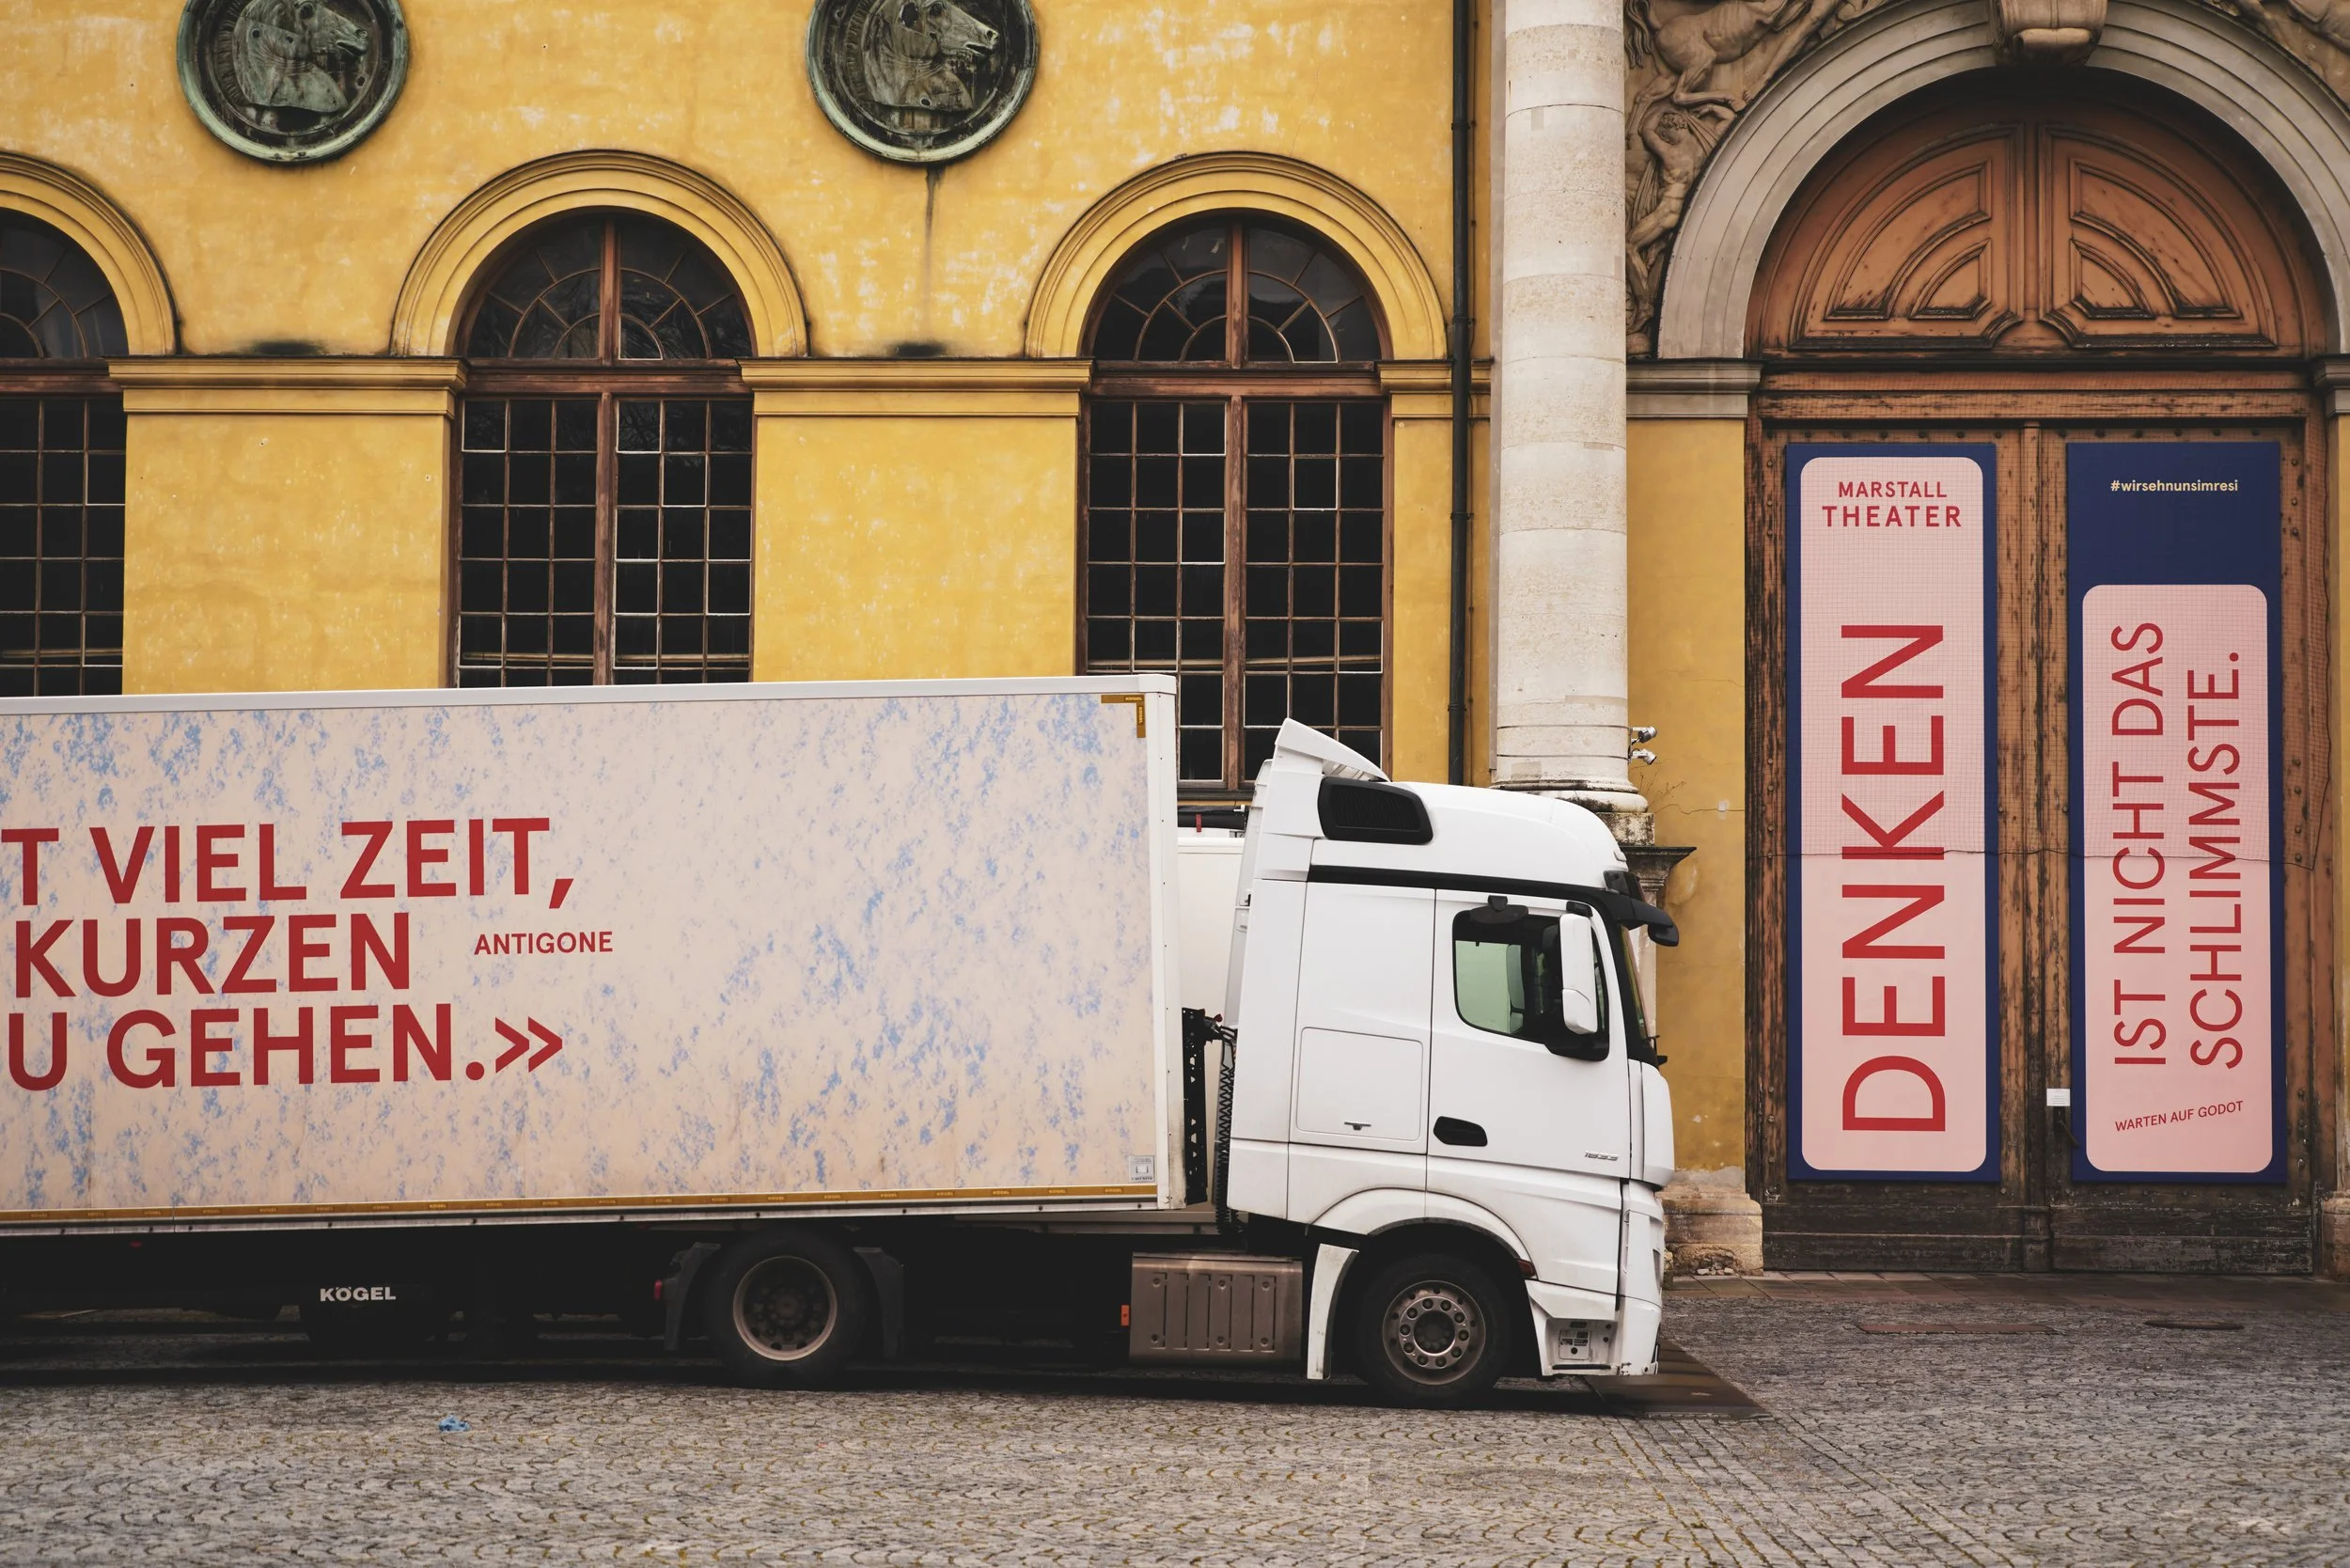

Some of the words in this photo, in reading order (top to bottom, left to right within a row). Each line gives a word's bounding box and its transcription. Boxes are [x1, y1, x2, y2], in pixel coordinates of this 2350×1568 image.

[1821, 505, 1962, 527] THEATER
[1839, 481, 1948, 498] MARSTALL
[2110, 479, 2238, 492] #wirsehnunsimresi
[2111, 622, 2164, 736] DAS
[1, 828, 59, 905] T
[90, 823, 306, 903] VIEL
[340, 818, 574, 909] ZEIT,
[1841, 625, 1946, 1132] DENKEN
[2111, 761, 2166, 954] NICHT
[2187, 651, 2243, 1070] SCHLIMMSTE.
[16, 913, 409, 998] KURZEN
[474, 931, 614, 955] ANTIGONE
[8, 1012, 67, 1090] U
[2113, 979, 2167, 1065] IST
[2115, 1113, 2167, 1132] WARTEN
[2170, 1109, 2195, 1123] AUF
[2198, 1101, 2244, 1118] GODOT
[320, 1287, 397, 1302] KÖGEL
